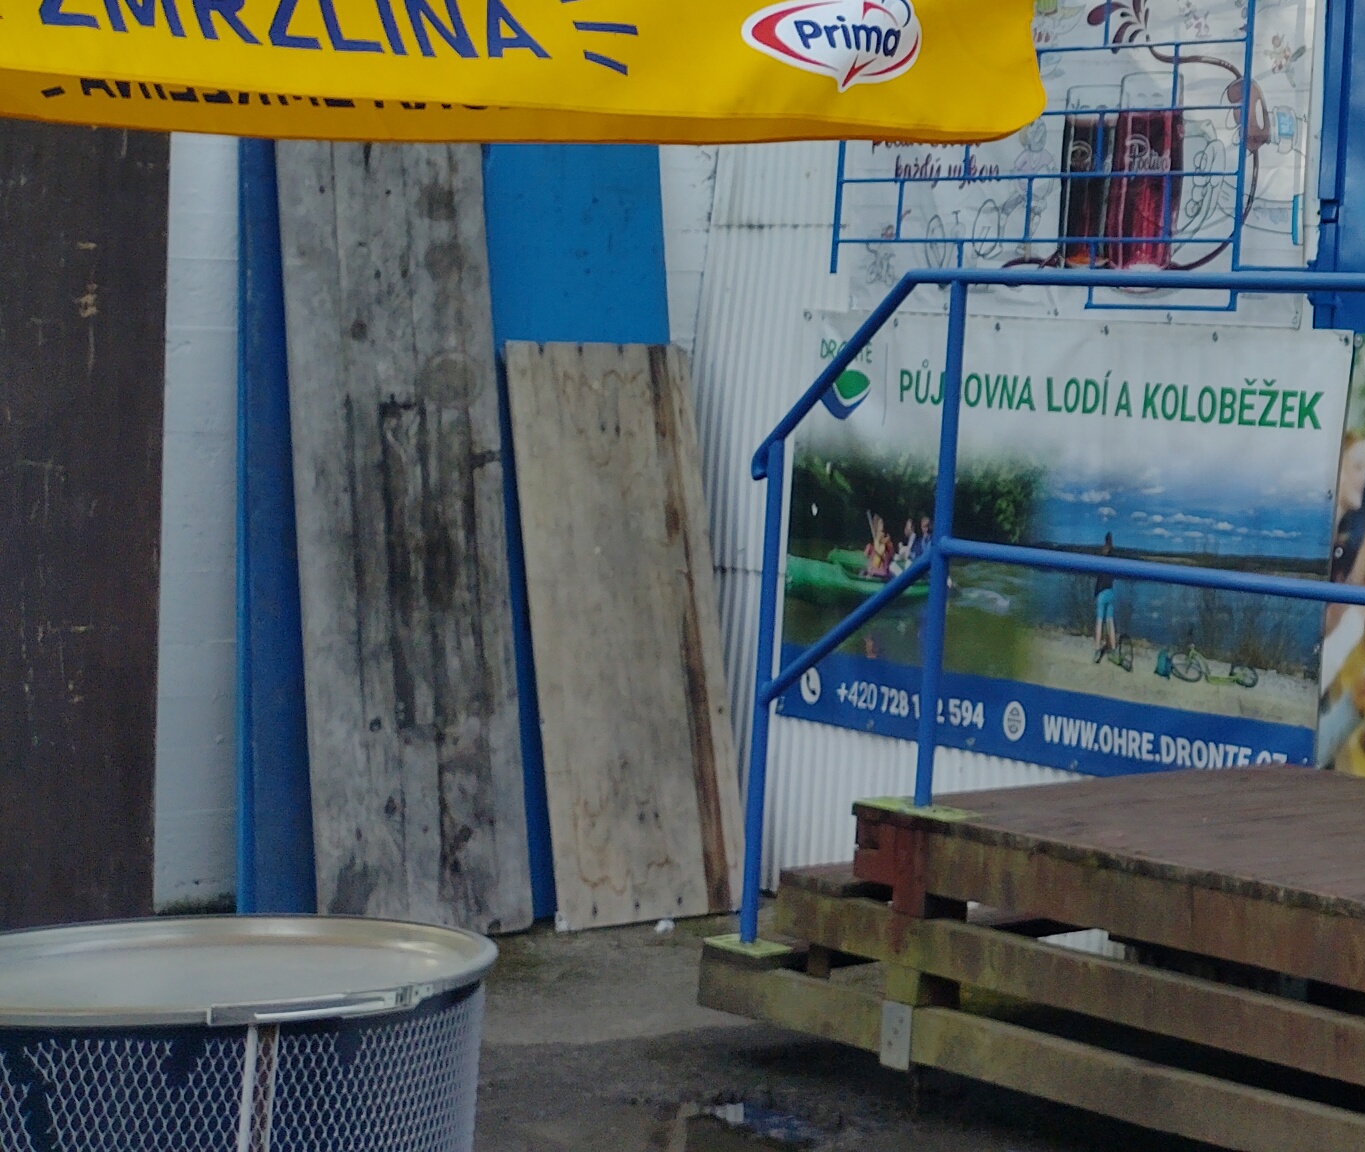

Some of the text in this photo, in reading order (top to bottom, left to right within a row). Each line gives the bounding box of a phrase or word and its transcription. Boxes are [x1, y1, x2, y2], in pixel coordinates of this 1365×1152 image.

[793, 12, 902, 59] Prima
[899, 358, 1325, 430] PŮJOVNA LODÍ A KOLOBĚŽEK
[837, 680, 877, 712] +420
[880, 685, 913, 715] 728
[948, 700, 984, 729] 594
[1043, 713, 1288, 770] WWW.OHRE.DRONTE
